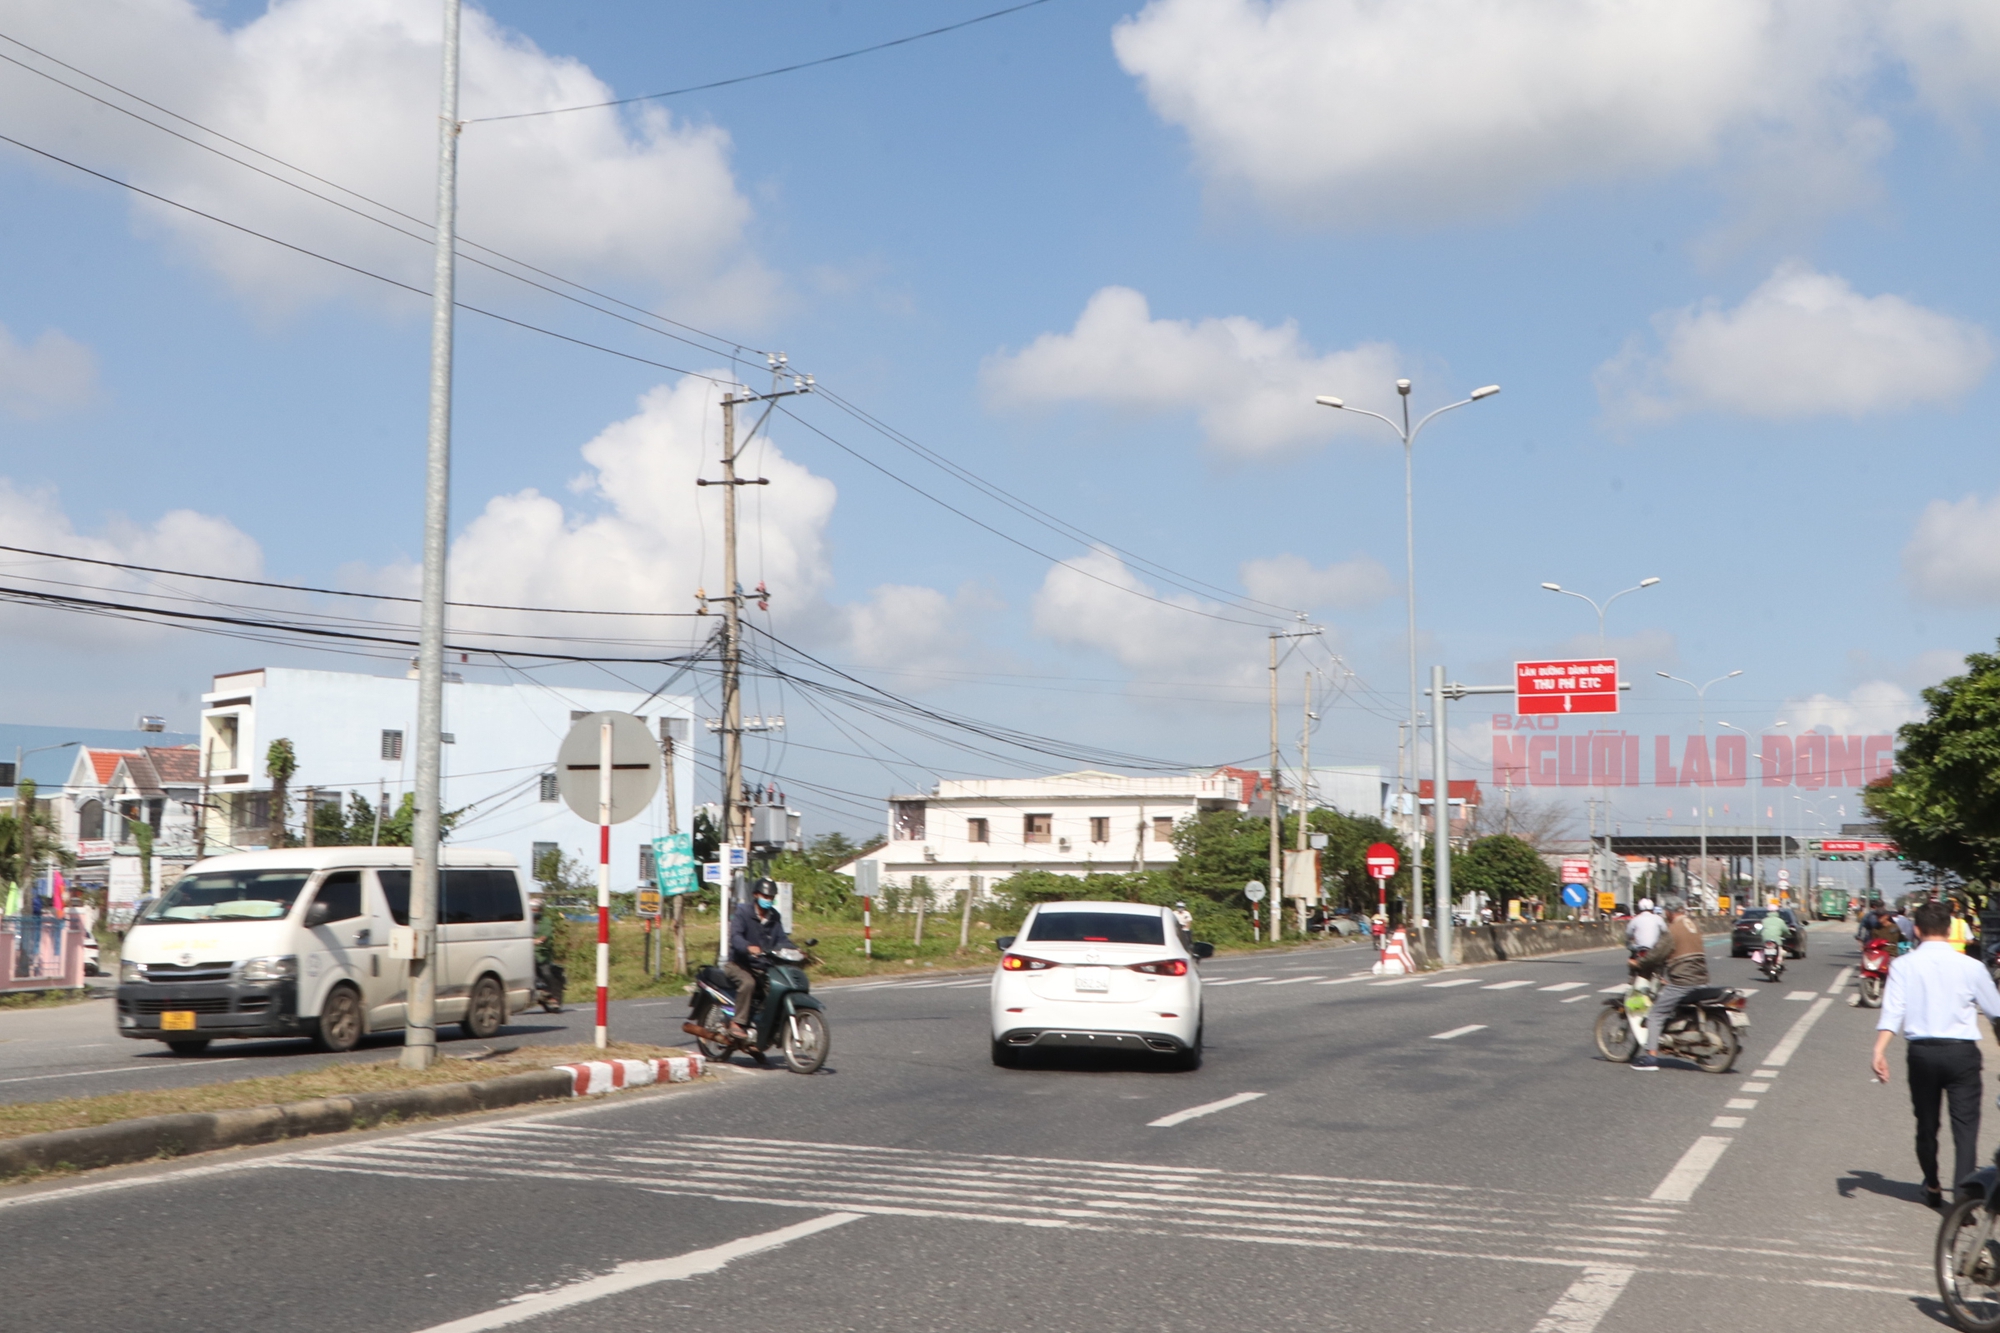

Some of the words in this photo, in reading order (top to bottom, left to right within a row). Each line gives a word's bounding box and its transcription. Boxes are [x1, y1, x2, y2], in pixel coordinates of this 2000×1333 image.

[1533, 679, 1555, 690] THU
[1557, 676, 1576, 689] PHÍ
[1579, 678, 1602, 689] ETC
